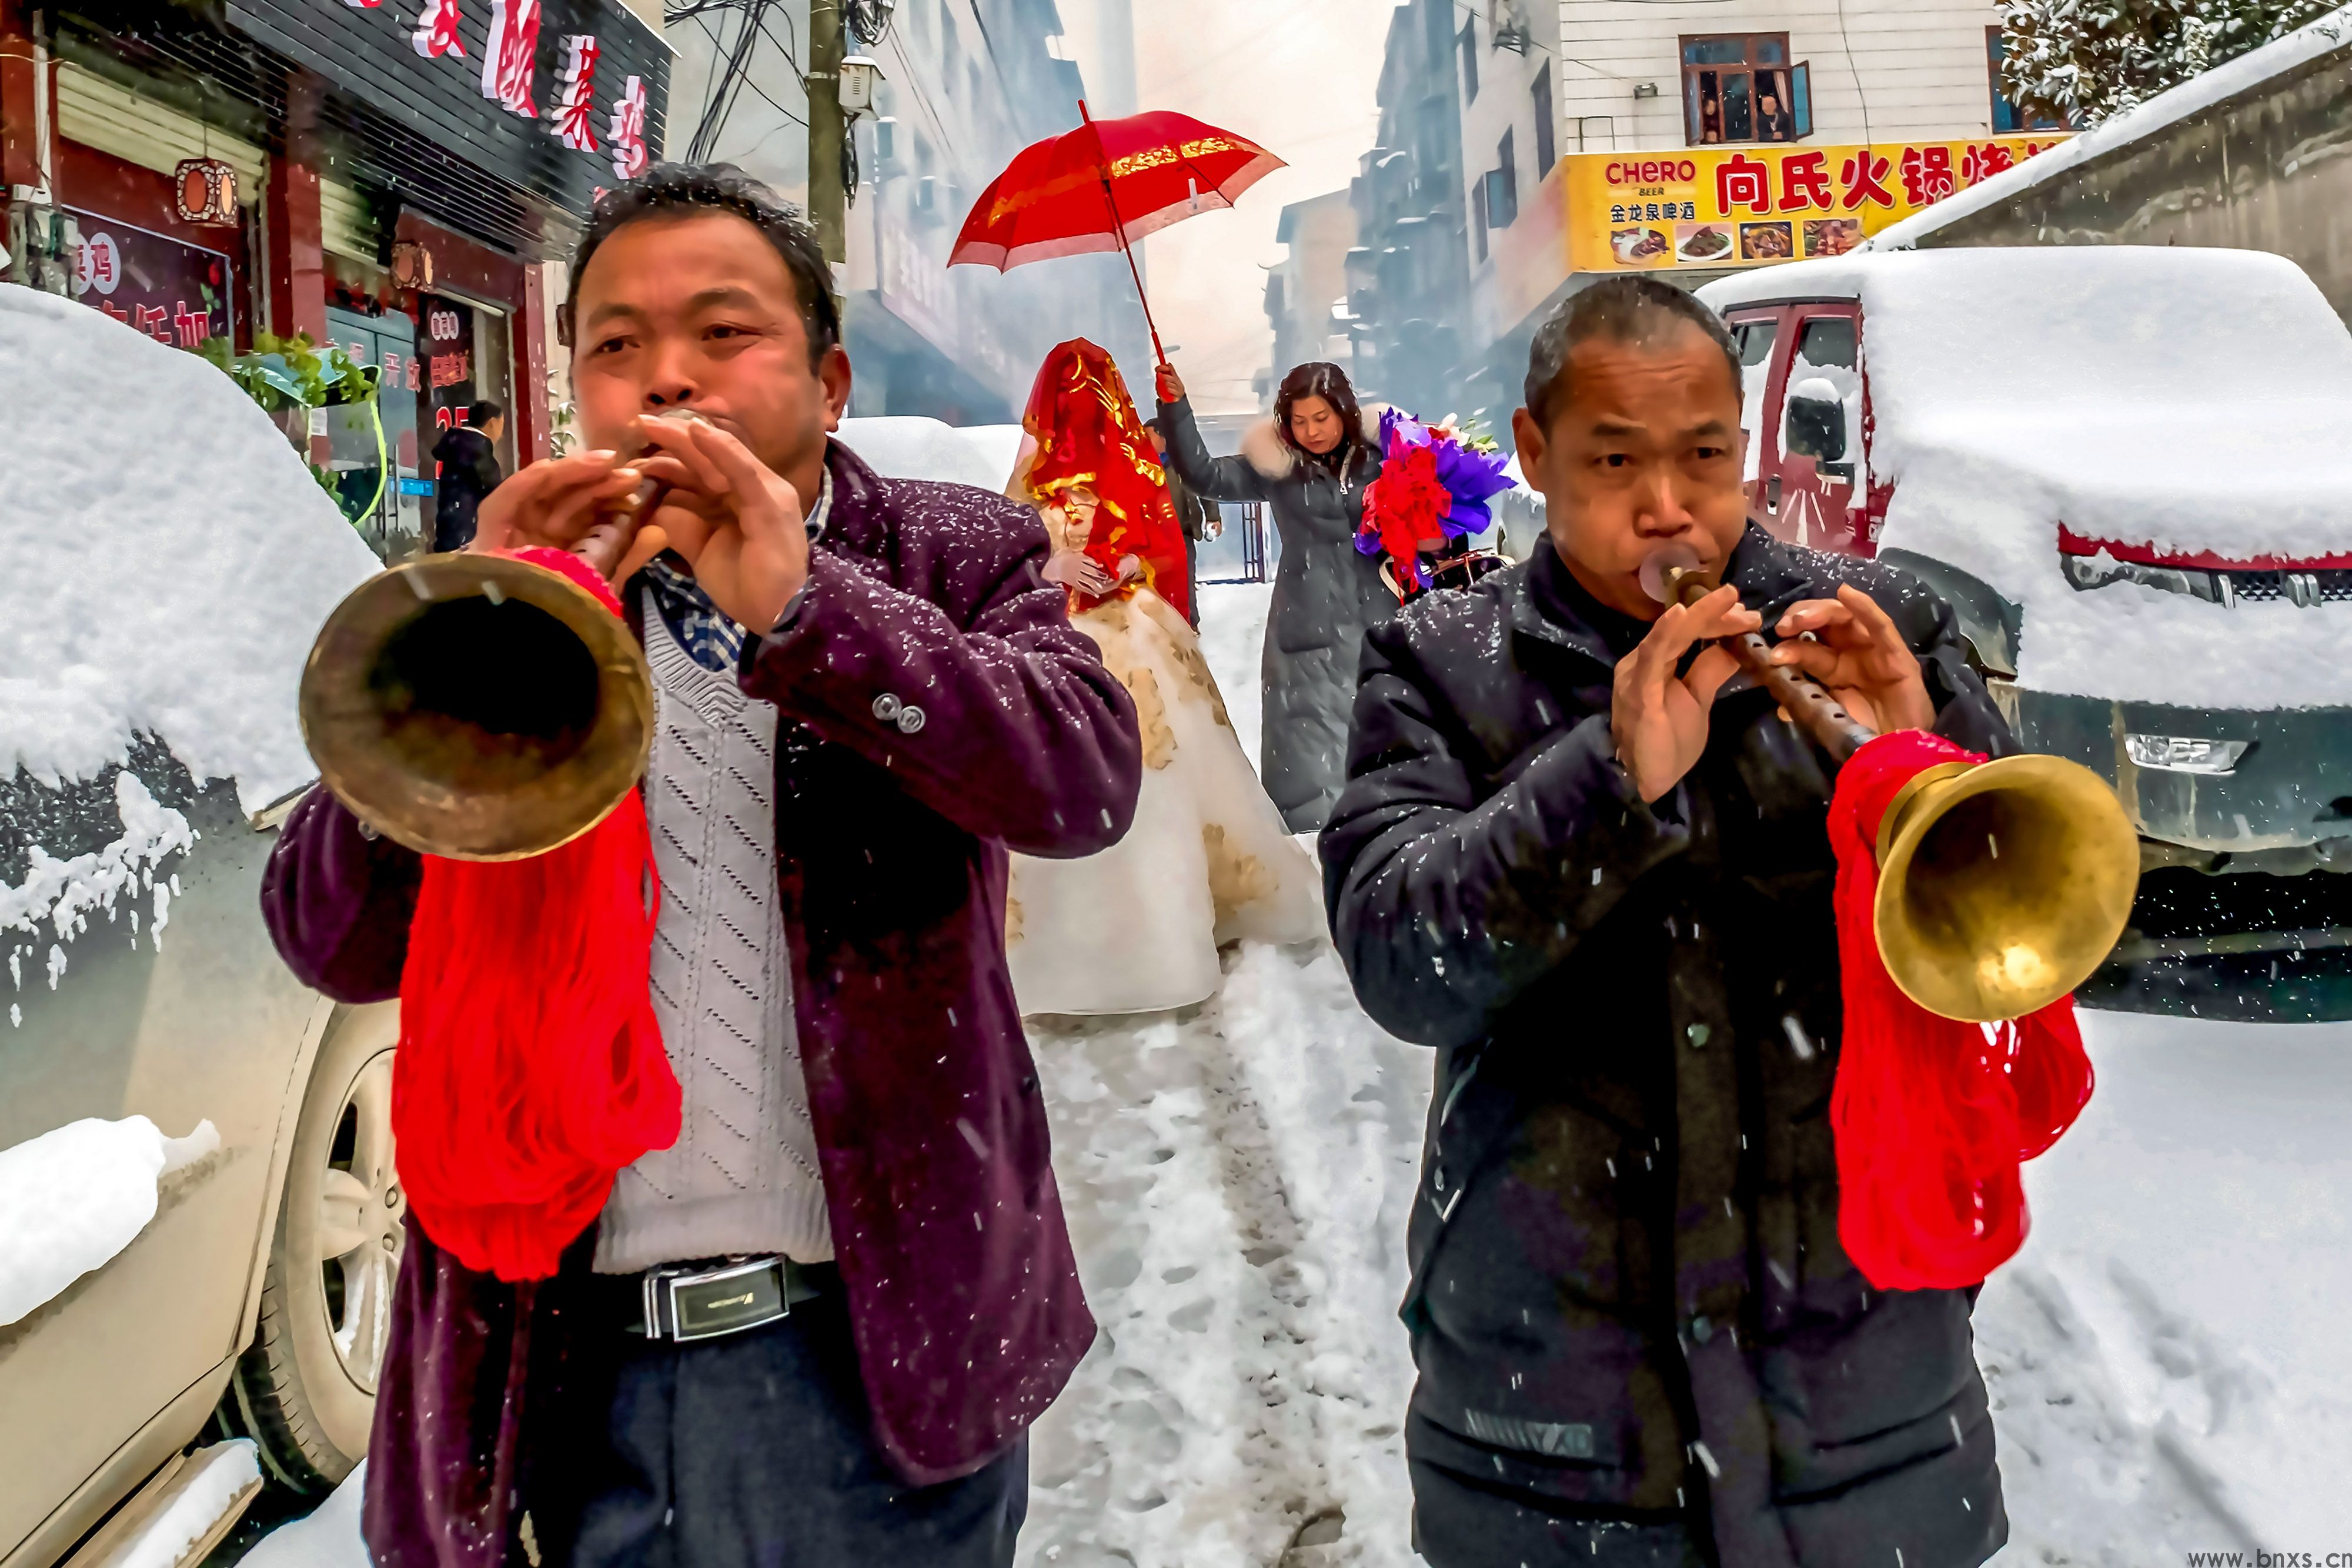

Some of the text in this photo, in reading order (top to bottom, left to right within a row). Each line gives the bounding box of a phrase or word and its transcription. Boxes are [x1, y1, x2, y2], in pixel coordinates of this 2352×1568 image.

[1638, 186, 1665, 197] BEER
[1610, 201, 1695, 223] 金龙泉啤酒
[91, 300, 211, 349] 任加
